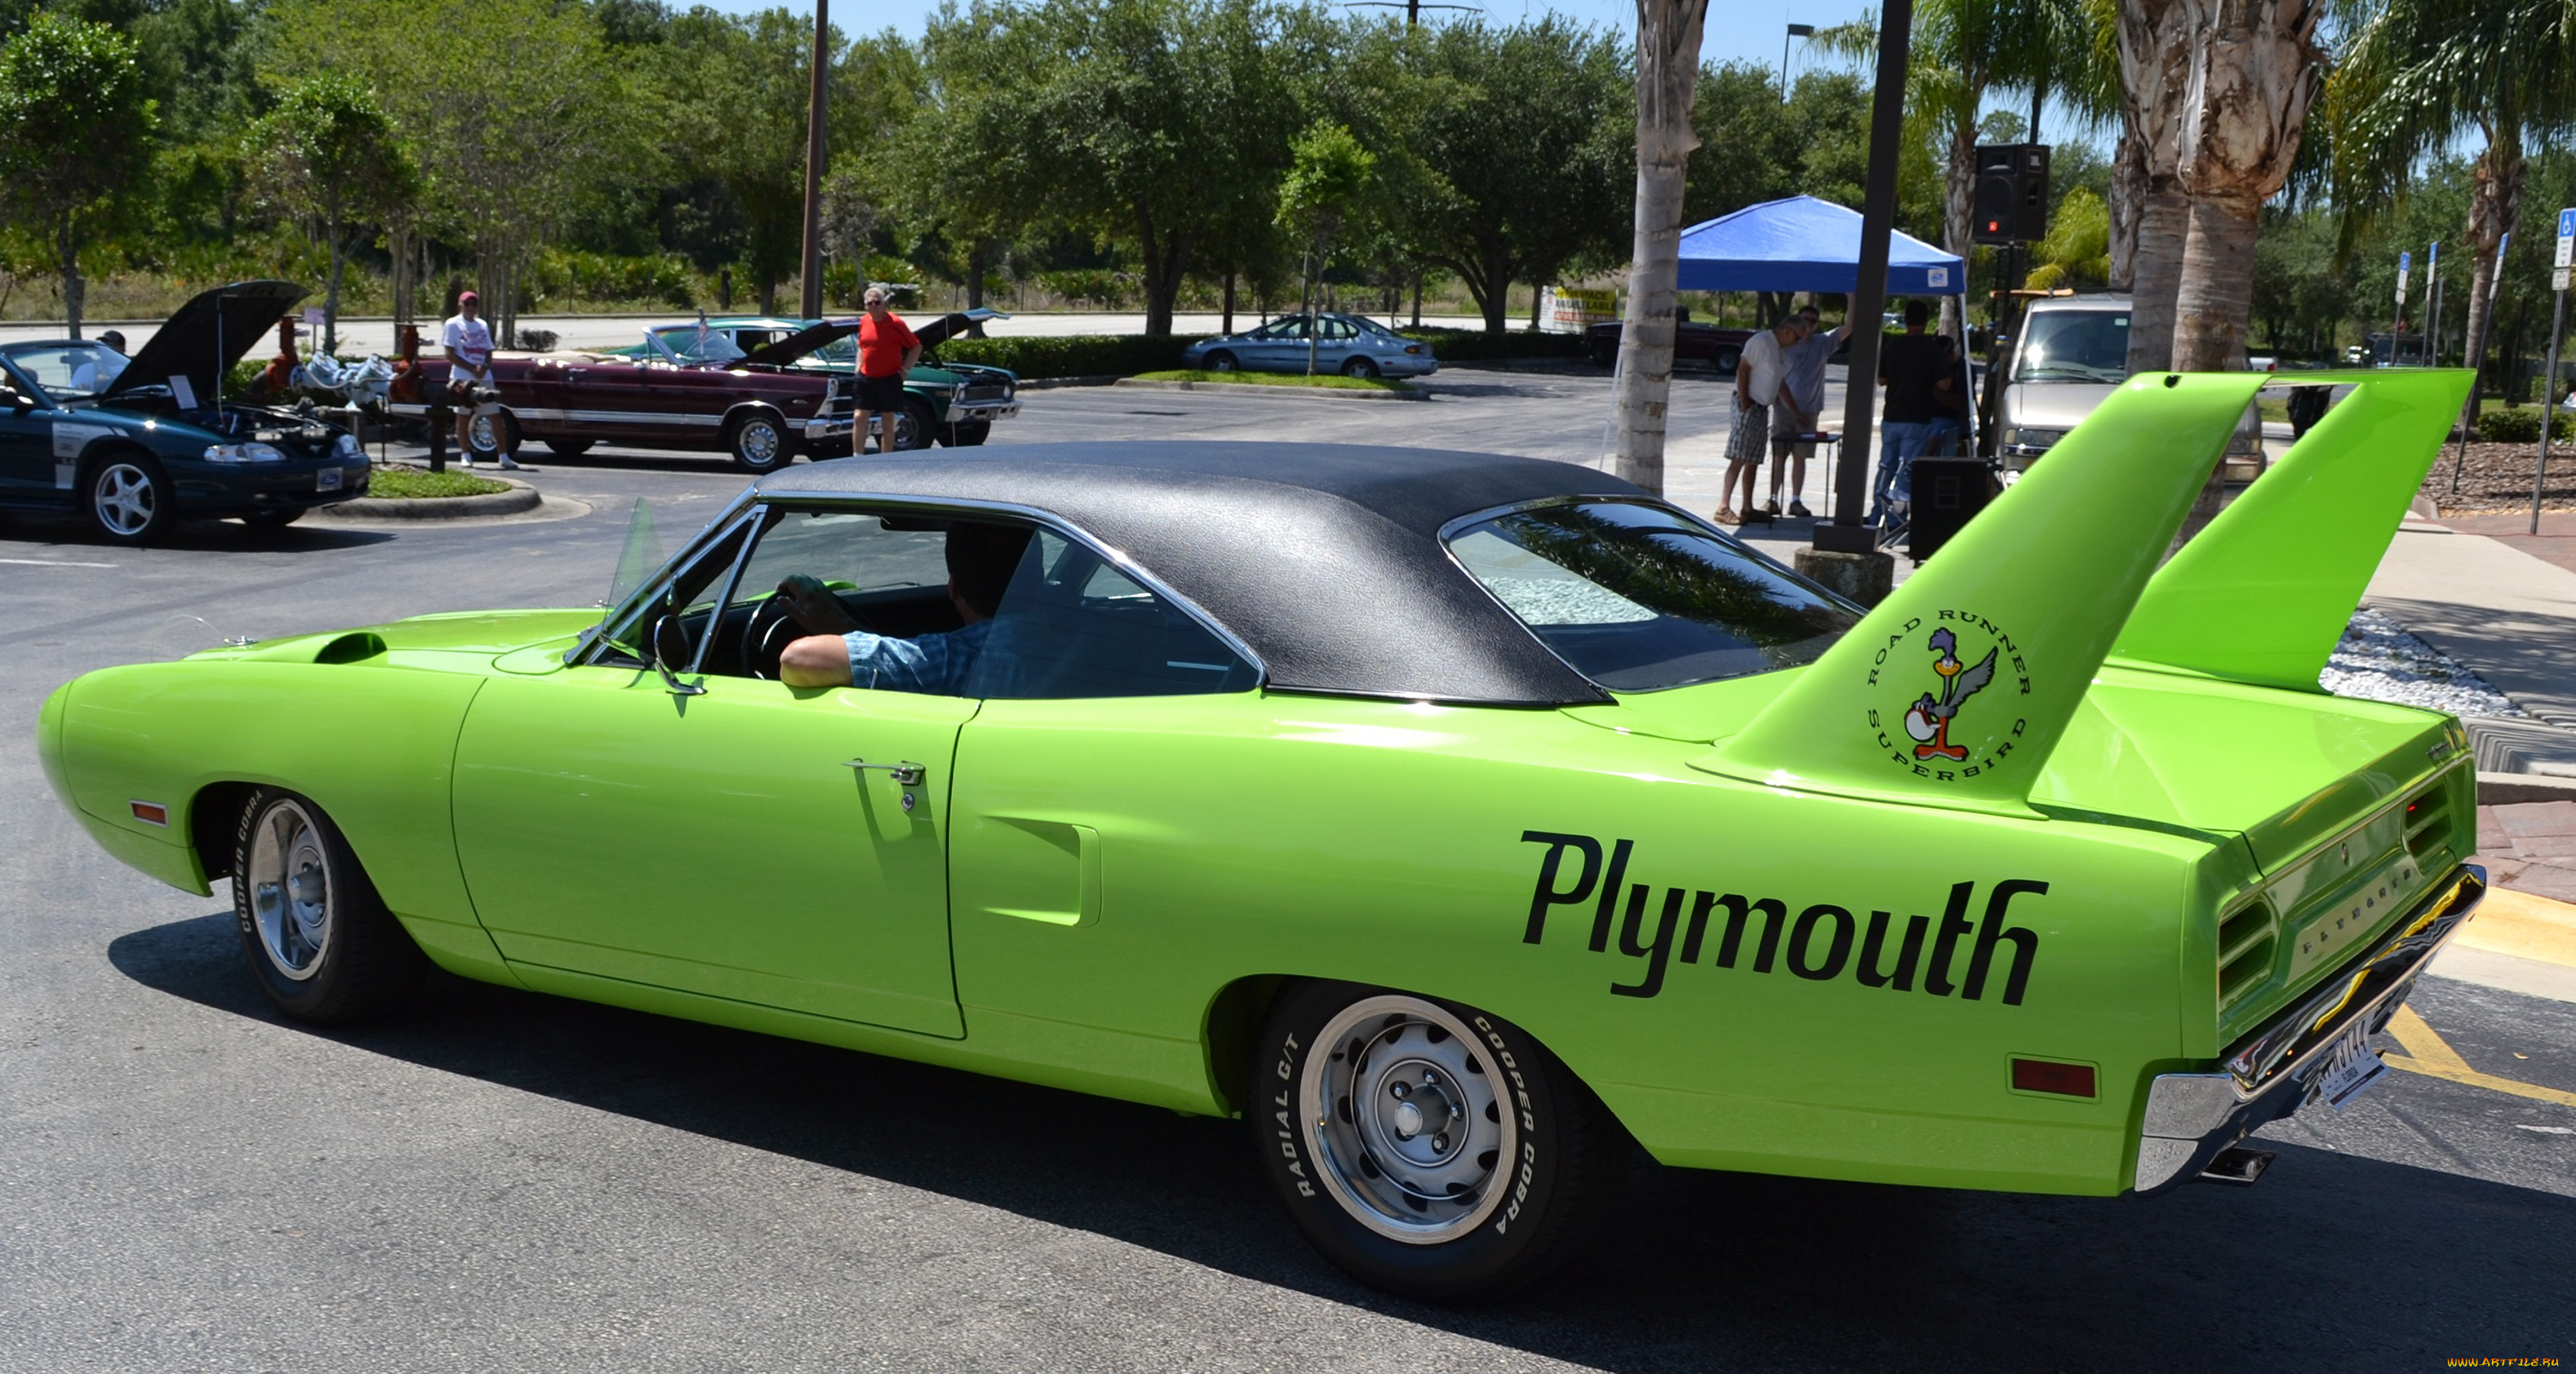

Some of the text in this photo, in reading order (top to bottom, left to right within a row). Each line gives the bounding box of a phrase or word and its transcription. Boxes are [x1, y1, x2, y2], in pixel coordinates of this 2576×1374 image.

[1868, 610, 2031, 696] ROAD RUNNER
[1868, 709, 2026, 781] SUPERBIRD
[235, 789, 263, 933] COOPER COBRA
[1520, 830, 2050, 1006] Plymouth
[1275, 1033, 1316, 1197] RADIAL G/T
[1474, 1016, 1535, 1236] COOPER COBRA
